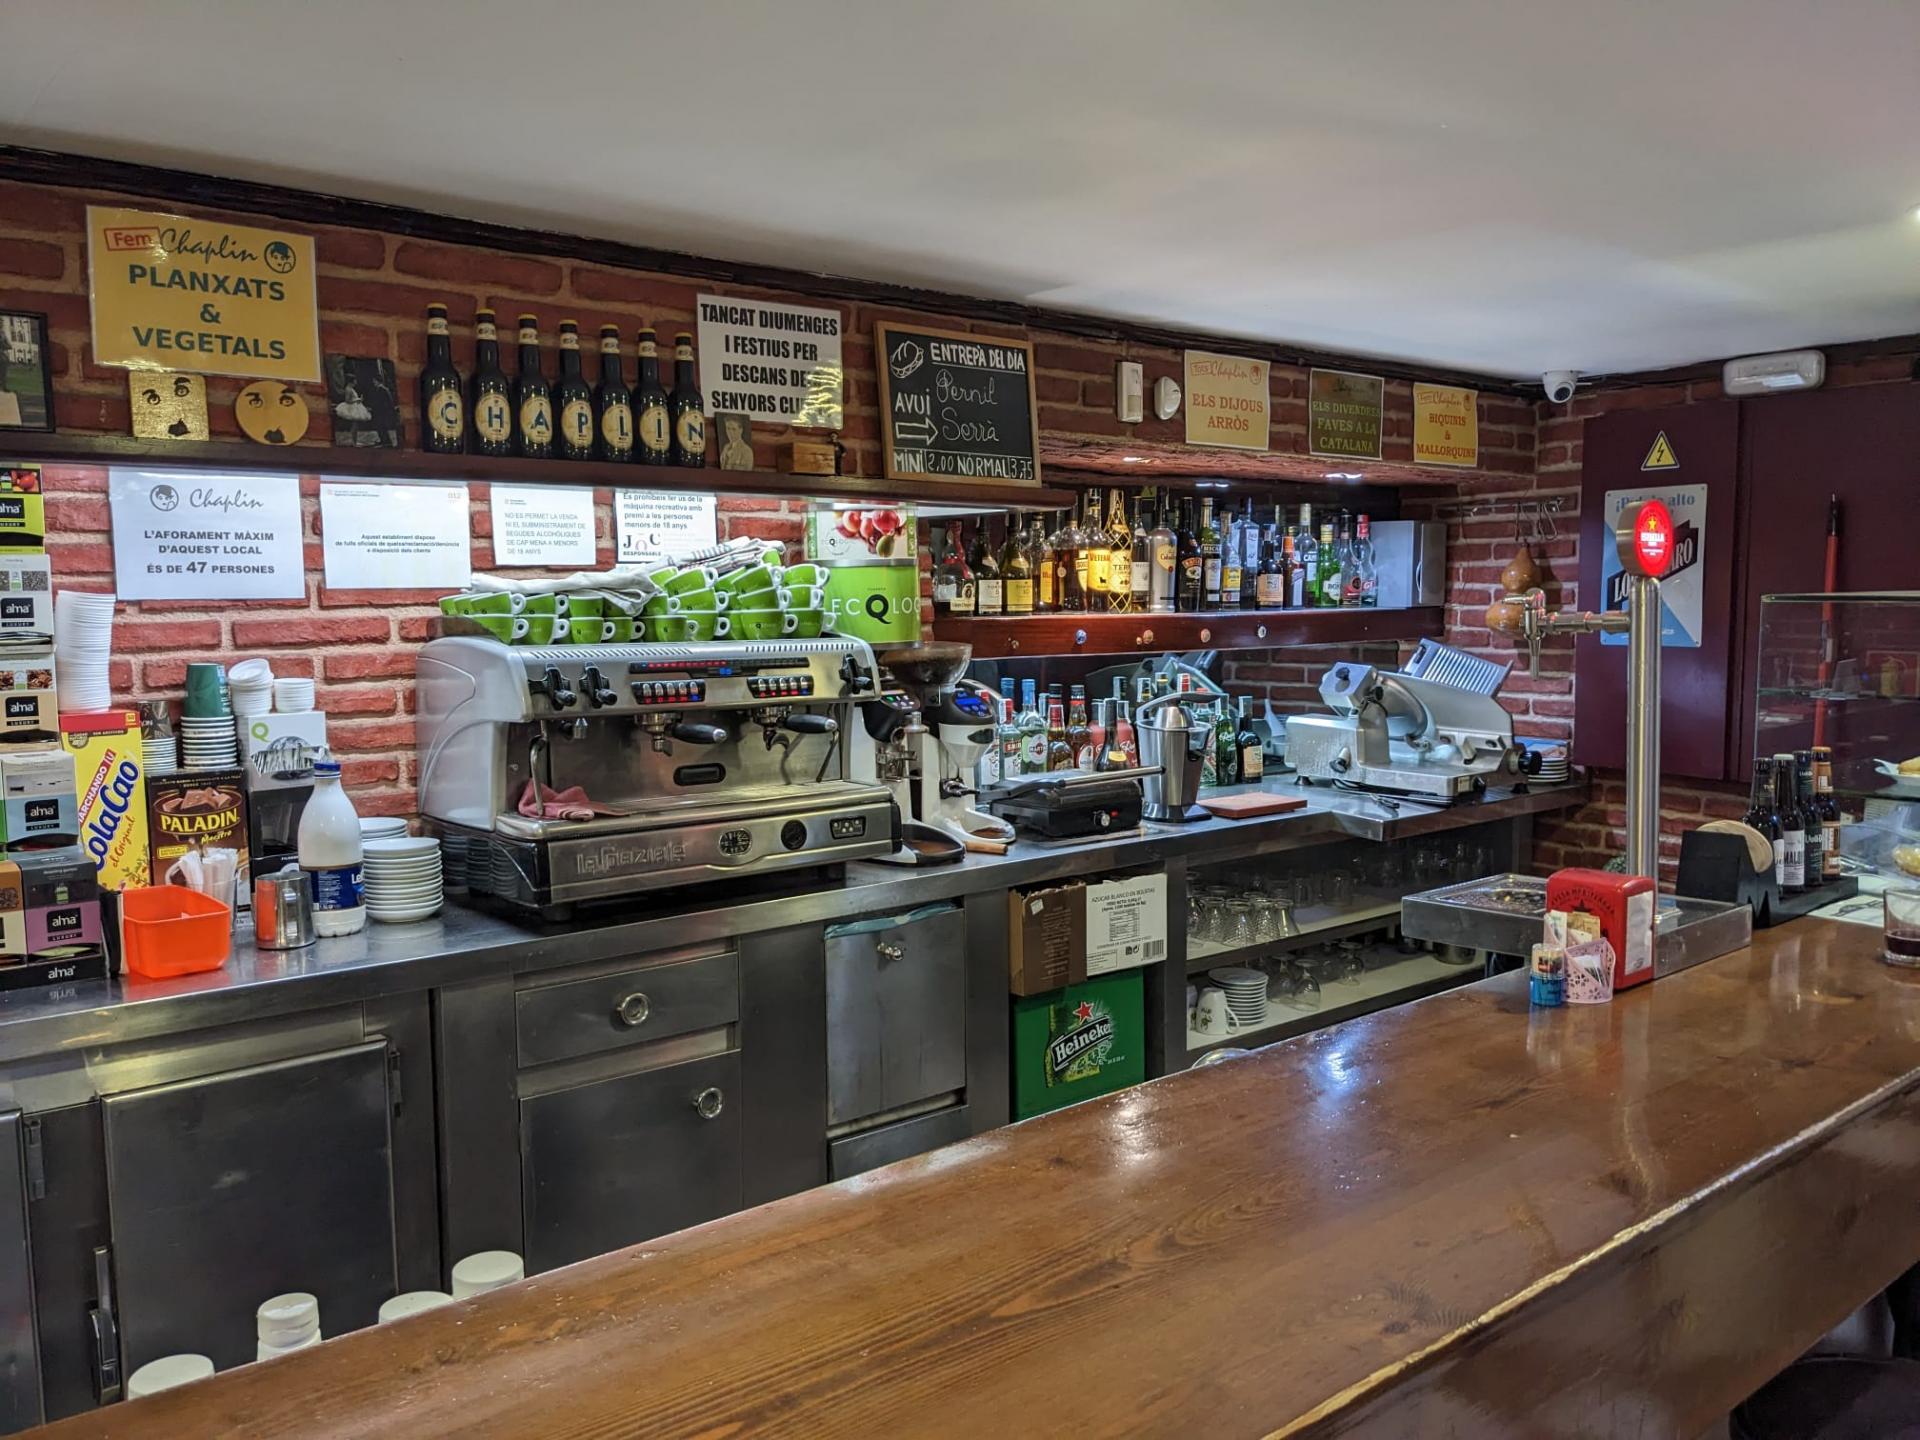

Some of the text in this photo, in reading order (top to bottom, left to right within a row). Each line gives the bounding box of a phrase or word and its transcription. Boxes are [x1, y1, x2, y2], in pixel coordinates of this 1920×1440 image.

[113, 227, 258, 264] Fem Chaplin
[128, 264, 285, 301] PLANXATS
[199, 303, 221, 324] &
[700, 304, 838, 336] TANCAT DIUMENGES
[132, 326, 286, 360] VEGETALS
[725, 334, 818, 361] I FESTIUS PER
[989, 349, 1005, 369] DEL
[722, 363, 787, 387] DESCANS
[936, 368, 998, 405] Pernil
[711, 390, 776, 414] SENYORS
[1192, 393, 1263, 413] ELS DIJOUS
[1317, 418, 1353, 432] FAVES
[1365, 422, 1376, 435] LA
[1320, 437, 1374, 452] CATALANA
[190, 488, 264, 516] Chaplin
[655, 503, 687, 511] recreativa
[624, 512, 644, 520] premi
[144, 530, 231, 541] L'AFORAMENT
[158, 545, 262, 555] D'AQUEST LOCAL
[166, 565, 183, 574] DE
[186, 561, 207, 574] 47
[211, 564, 275, 575] PERSONES
[6, 601, 29, 614] alma
[10, 702, 34, 713] alma
[30, 806, 54, 817] alma
[160, 807, 237, 832] PALADIN
[52, 915, 76, 927] alma
[48, 968, 74, 979] alma
